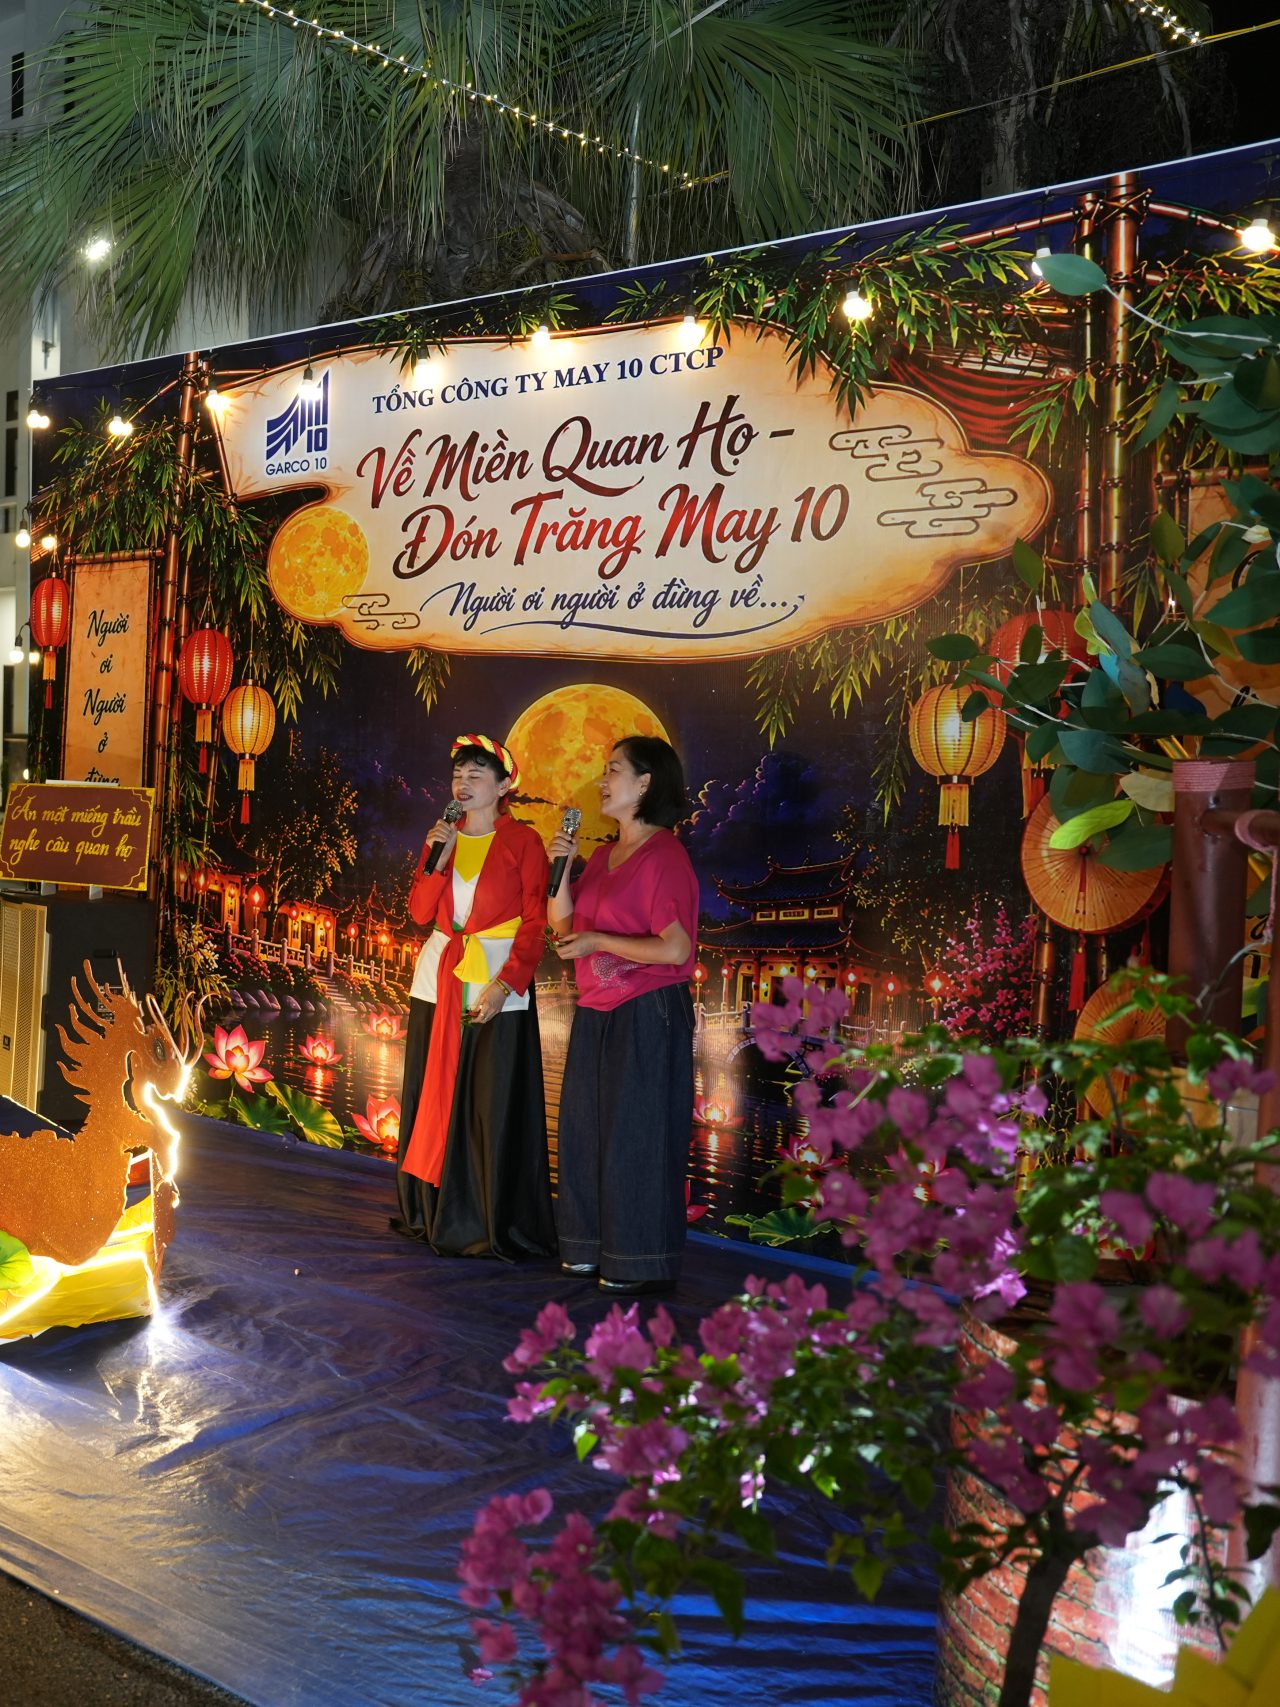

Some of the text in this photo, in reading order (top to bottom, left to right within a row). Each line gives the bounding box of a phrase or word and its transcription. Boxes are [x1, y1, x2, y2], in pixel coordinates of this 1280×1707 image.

[372, 346, 724, 414] TỔNG CÔNG TY MAY 10 CTCP
[265, 457, 327, 476] GARCO 10
[357, 428, 423, 509] Về
[423, 429, 534, 502] Miền
[542, 416, 669, 497] Quan
[677, 395, 759, 477] Họ
[392, 482, 850, 580] Đón Trăng May 10
[420, 573, 788, 632] Người ơi người ở đừng về...
[86, 610, 130, 647] Người
[99, 653, 114, 675] ơi
[83, 688, 128, 726] Người
[98, 732, 109, 754] ở
[11, 794, 142, 838] Ăn một miếng trầu
[9, 828, 138, 866] nghe câu quan họ
